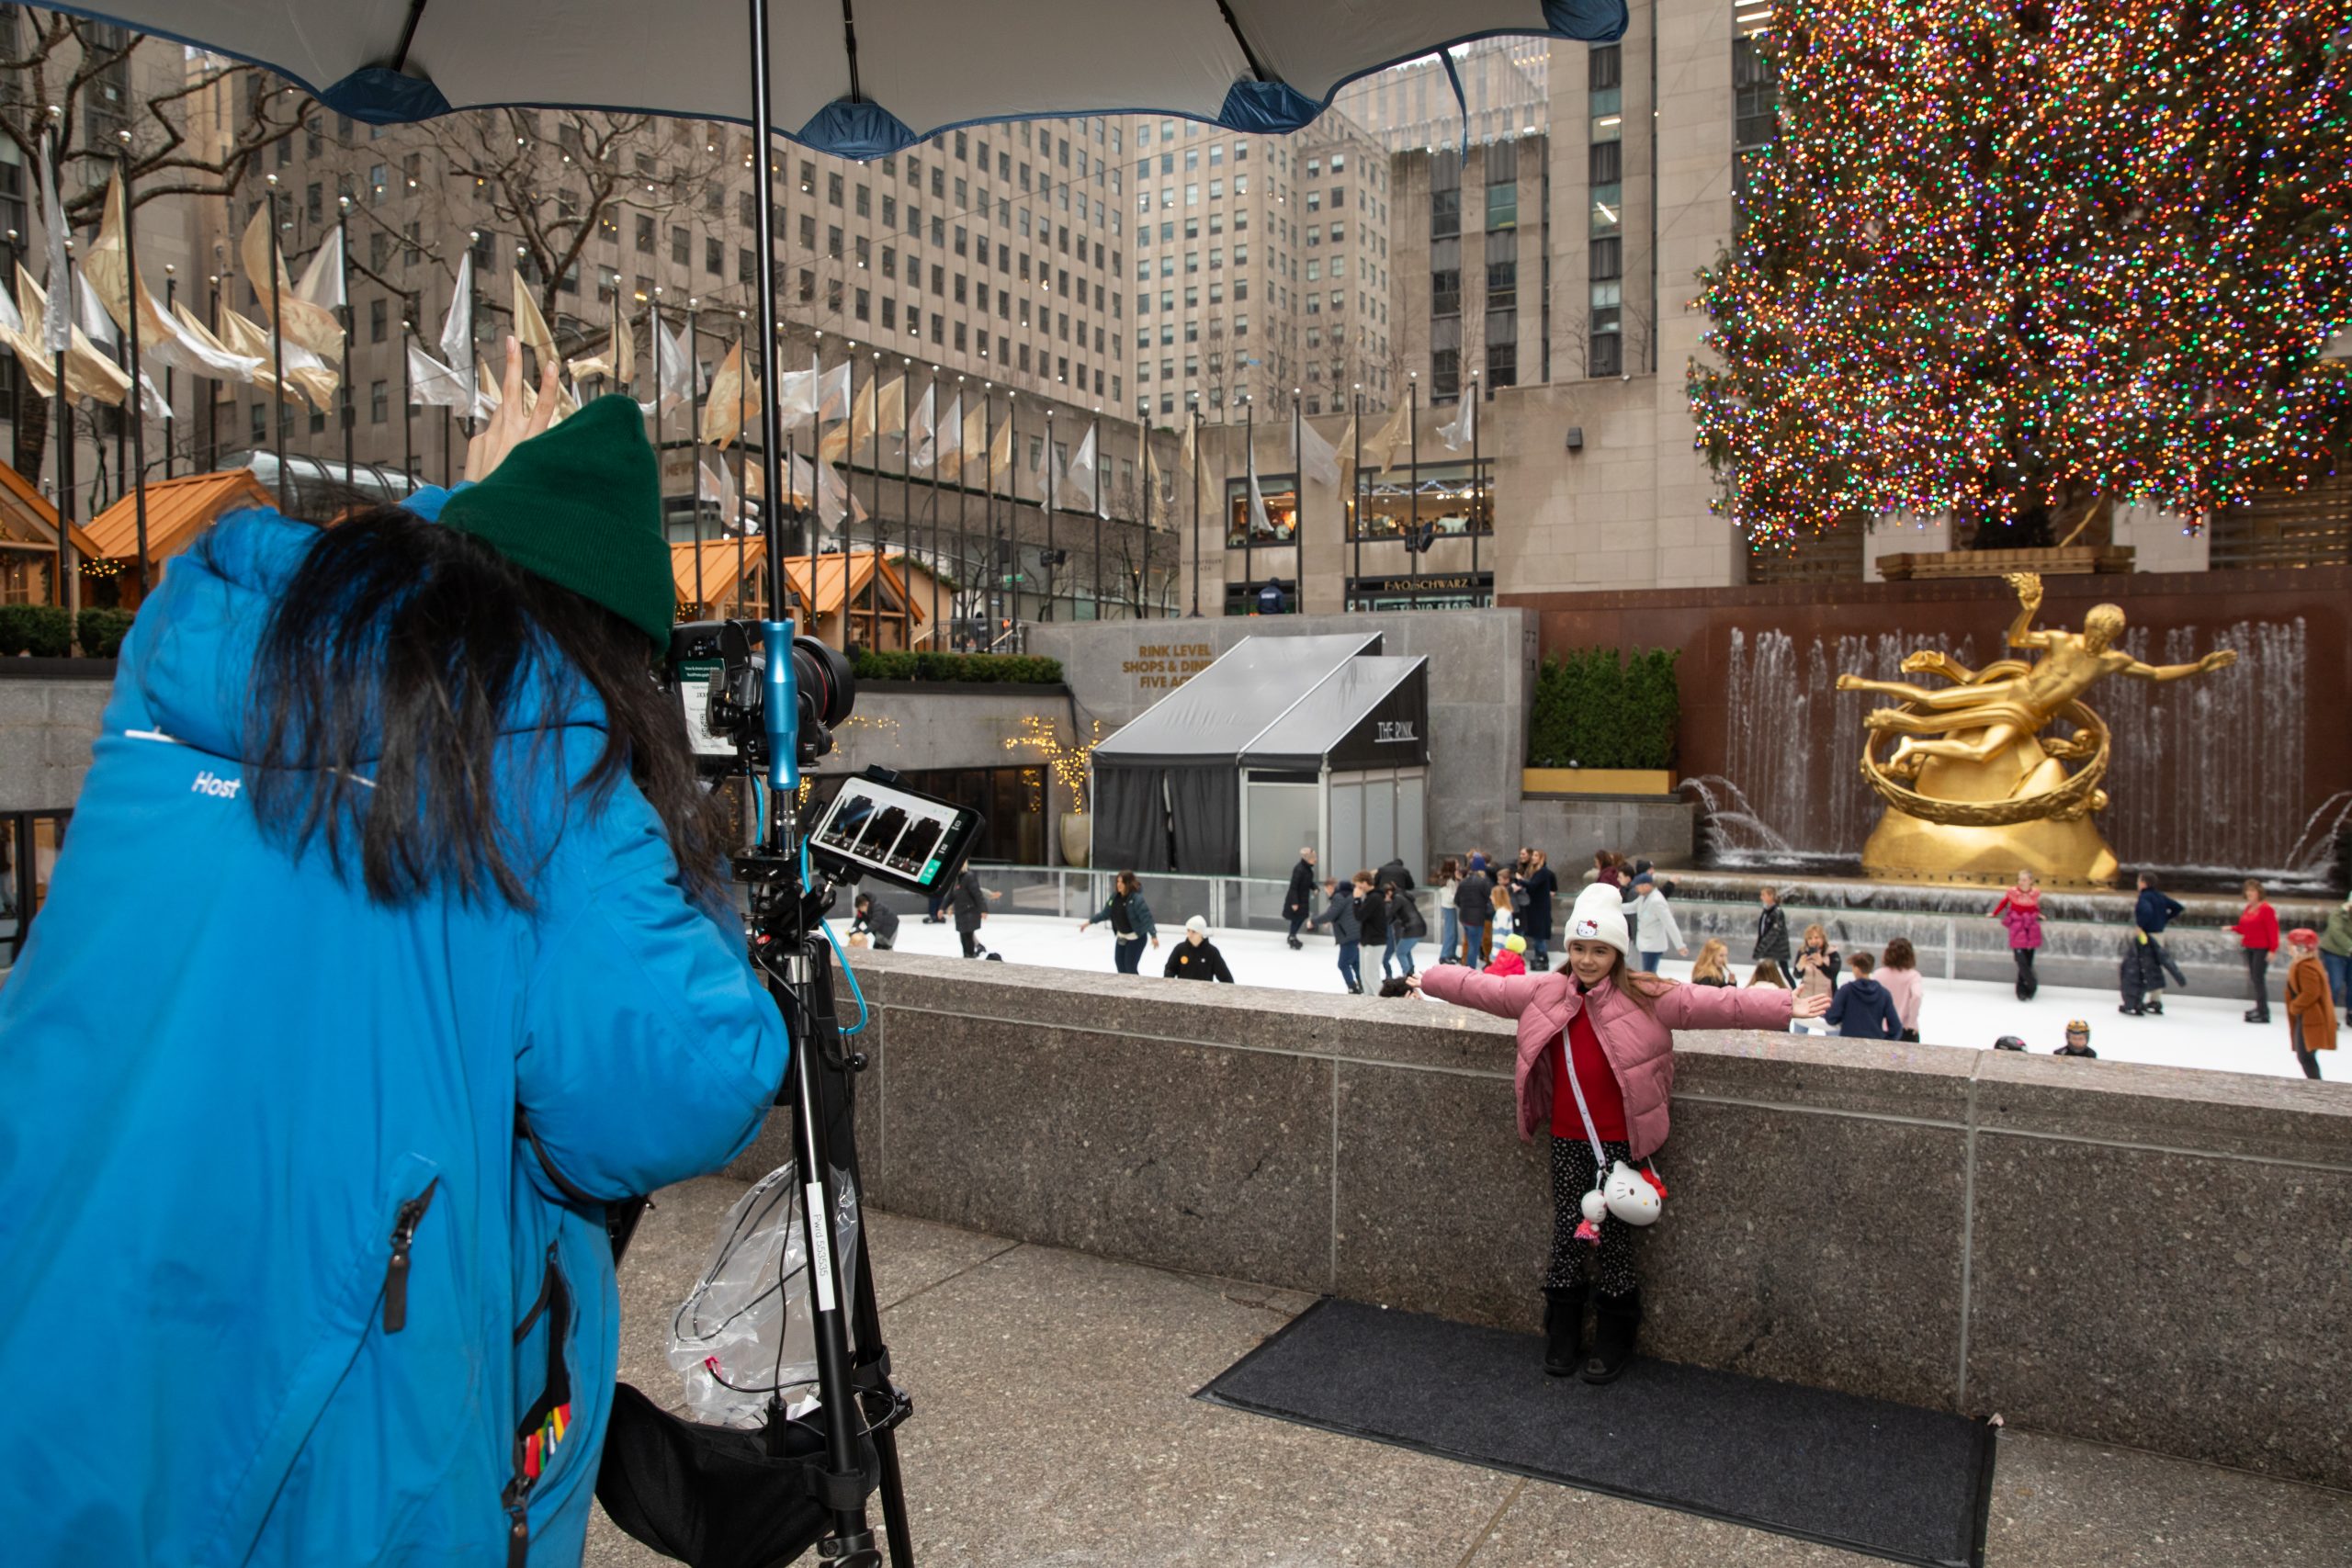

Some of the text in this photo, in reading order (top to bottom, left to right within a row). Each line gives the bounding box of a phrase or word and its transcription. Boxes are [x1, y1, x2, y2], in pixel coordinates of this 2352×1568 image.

[1413, 579, 1468, 590] SCHWARZ
[1139, 644, 1212, 657] RINK LEVEL
[1123, 661, 1165, 672] SHOPS
[1168, 661, 1177, 672] &
[1140, 677, 1167, 687] FIVE
[1377, 721, 1414, 739] THE RINK
[191, 771, 241, 798] Host
[817, 1240, 828, 1277] 553535
